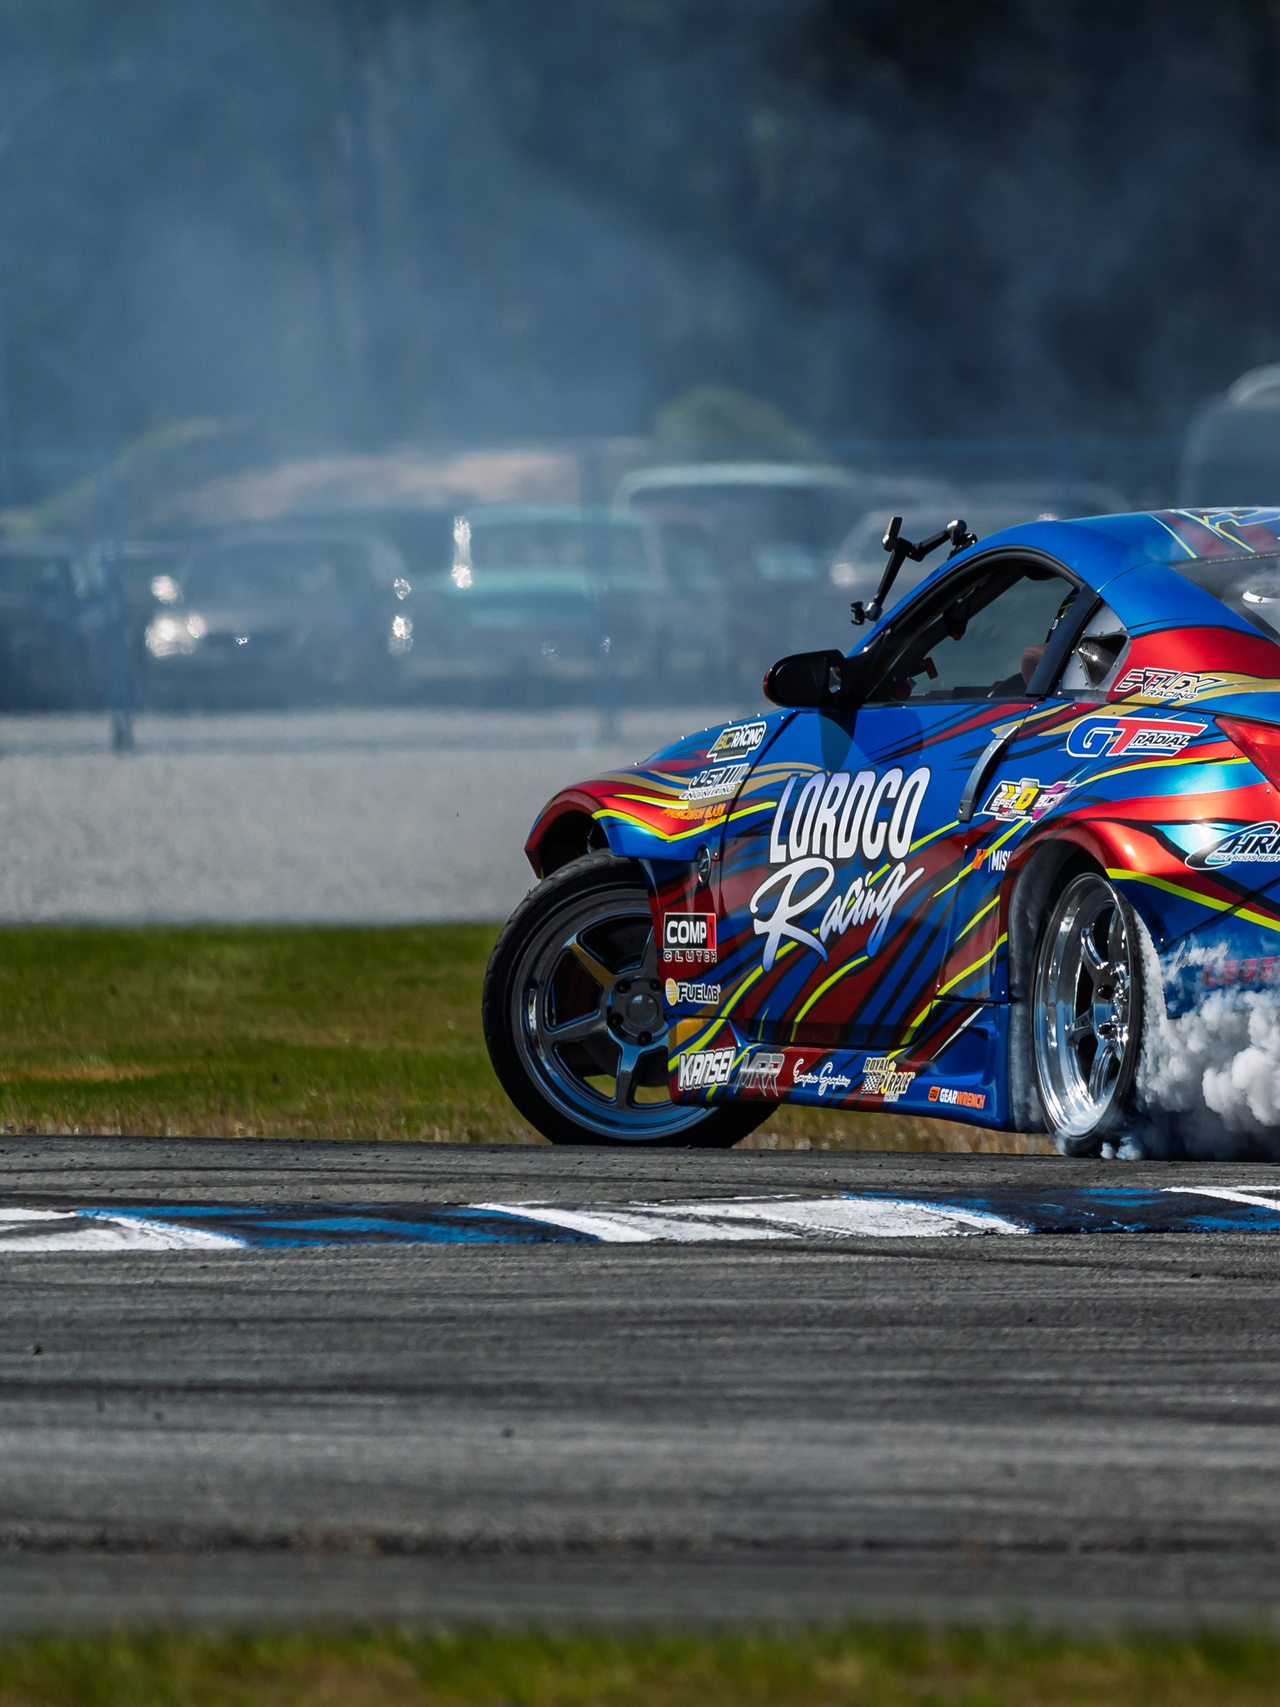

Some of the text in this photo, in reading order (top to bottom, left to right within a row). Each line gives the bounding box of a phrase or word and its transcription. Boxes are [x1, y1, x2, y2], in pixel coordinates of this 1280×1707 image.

[1146, 688, 1197, 700] RACING
[1067, 716, 1208, 757] GT RADIAL
[769, 766, 931, 864] LORDCO
[749, 856, 926, 972] Racing
[663, 950, 718, 963] CLUTCH
[679, 1047, 736, 1091] KANSEI
[733, 1053, 785, 1097] MRR
[862, 1057, 889, 1073] ROYAL
[876, 1071, 914, 1094] PURPLE
[939, 1087, 986, 1110] GEARWRENCH
